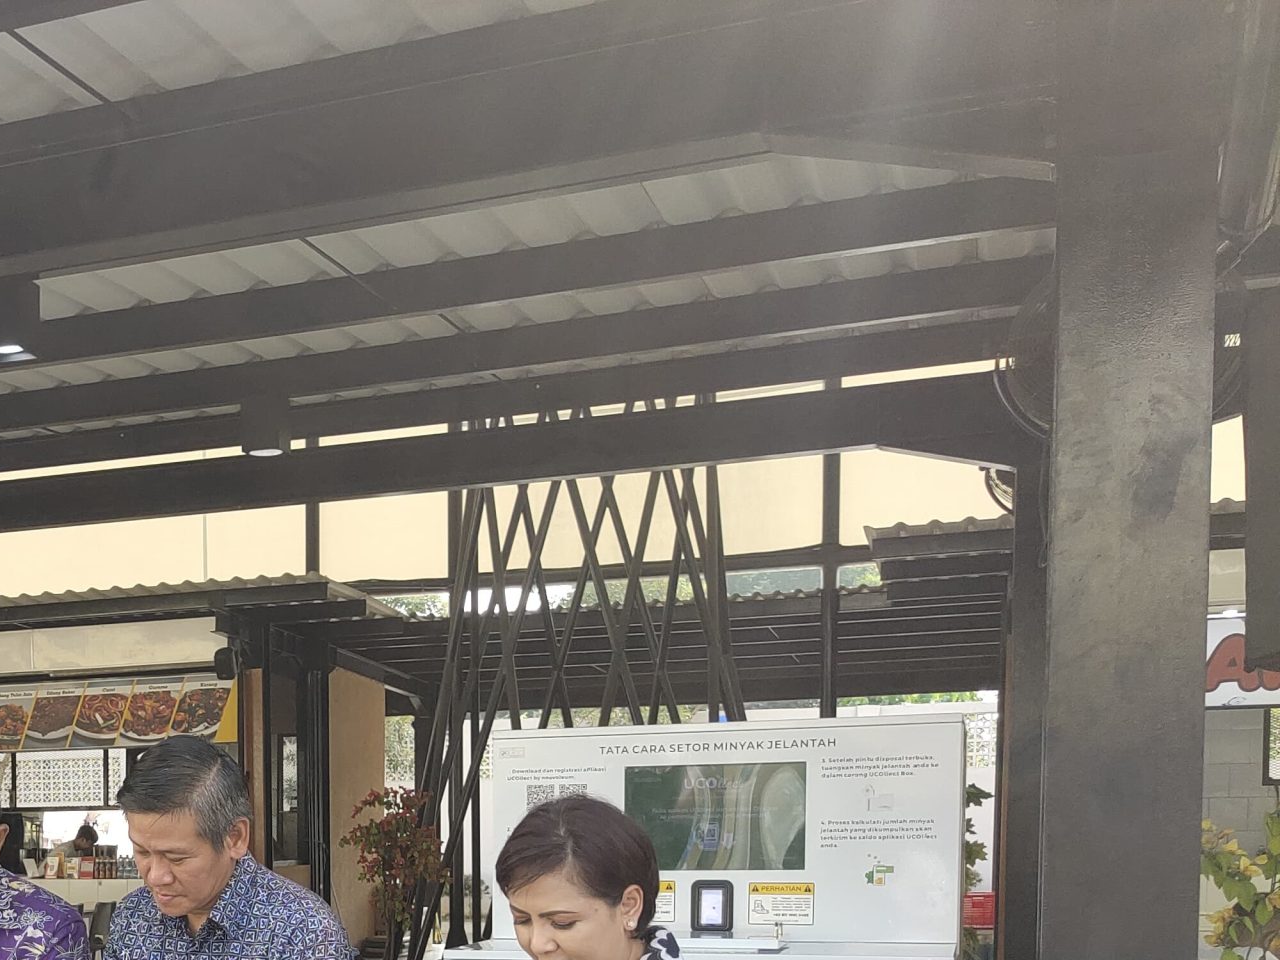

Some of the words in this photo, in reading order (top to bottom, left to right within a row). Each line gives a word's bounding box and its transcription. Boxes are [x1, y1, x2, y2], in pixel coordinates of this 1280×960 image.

[599, 746, 629, 755] TATA
[632, 744, 666, 754] CARA
[669, 743, 710, 753] SETOR
[713, 740, 765, 752] MINYAK
[767, 738, 837, 750] JELANTAH
